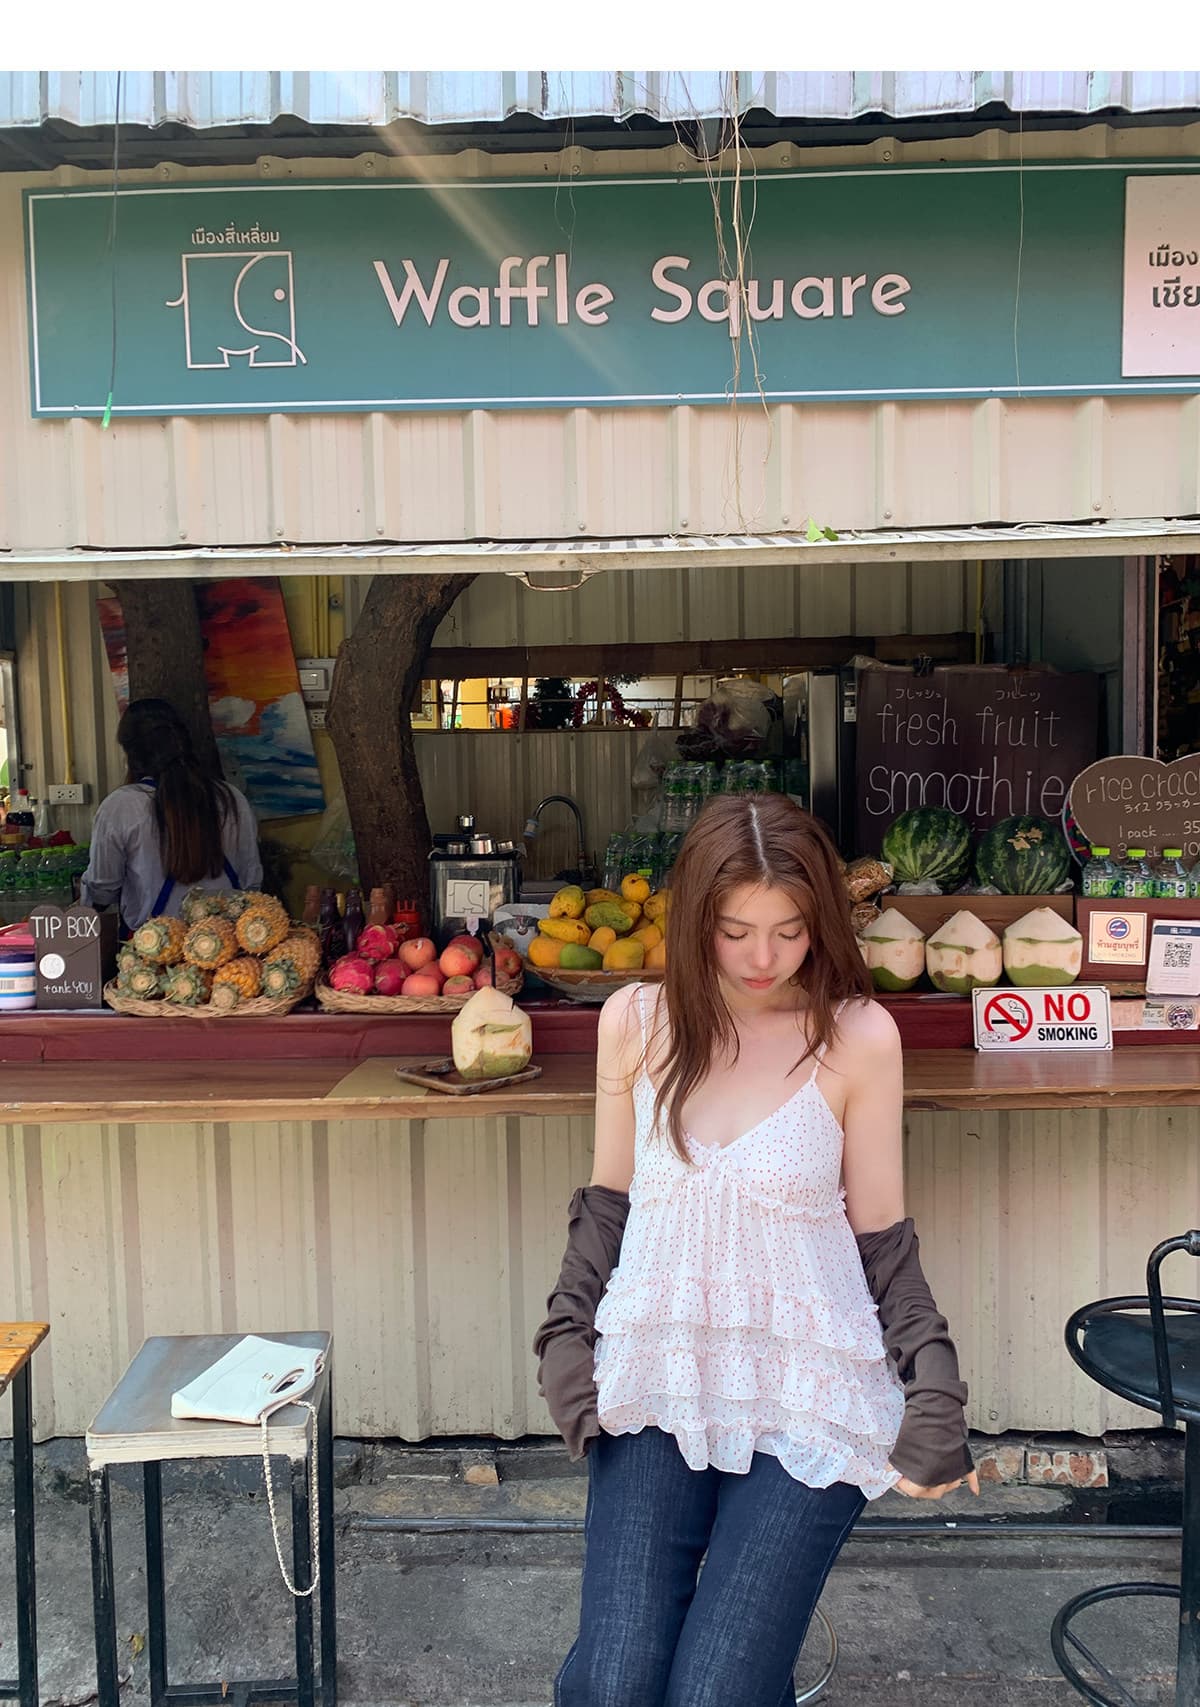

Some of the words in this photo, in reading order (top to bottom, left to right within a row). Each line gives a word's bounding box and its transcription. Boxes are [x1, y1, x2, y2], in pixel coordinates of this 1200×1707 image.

[1149, 244, 1198, 267] เมือง
[373, 253, 614, 328] Waffle
[650, 255, 912, 337] Square
[876, 698, 958, 746] fresh
[976, 706, 1061, 748] fruit
[865, 756, 1064, 817] smoothie
[1086, 776, 1133, 803] rice
[1140, 770, 1200, 799] crac
[1127, 825, 1157, 839] pack
[1118, 842, 1128, 859] 3
[30, 916, 62, 938] TIP
[67, 916, 98, 938] BOX
[1043, 993, 1091, 1022] NO
[1037, 1026, 1098, 1041] SMOKING
